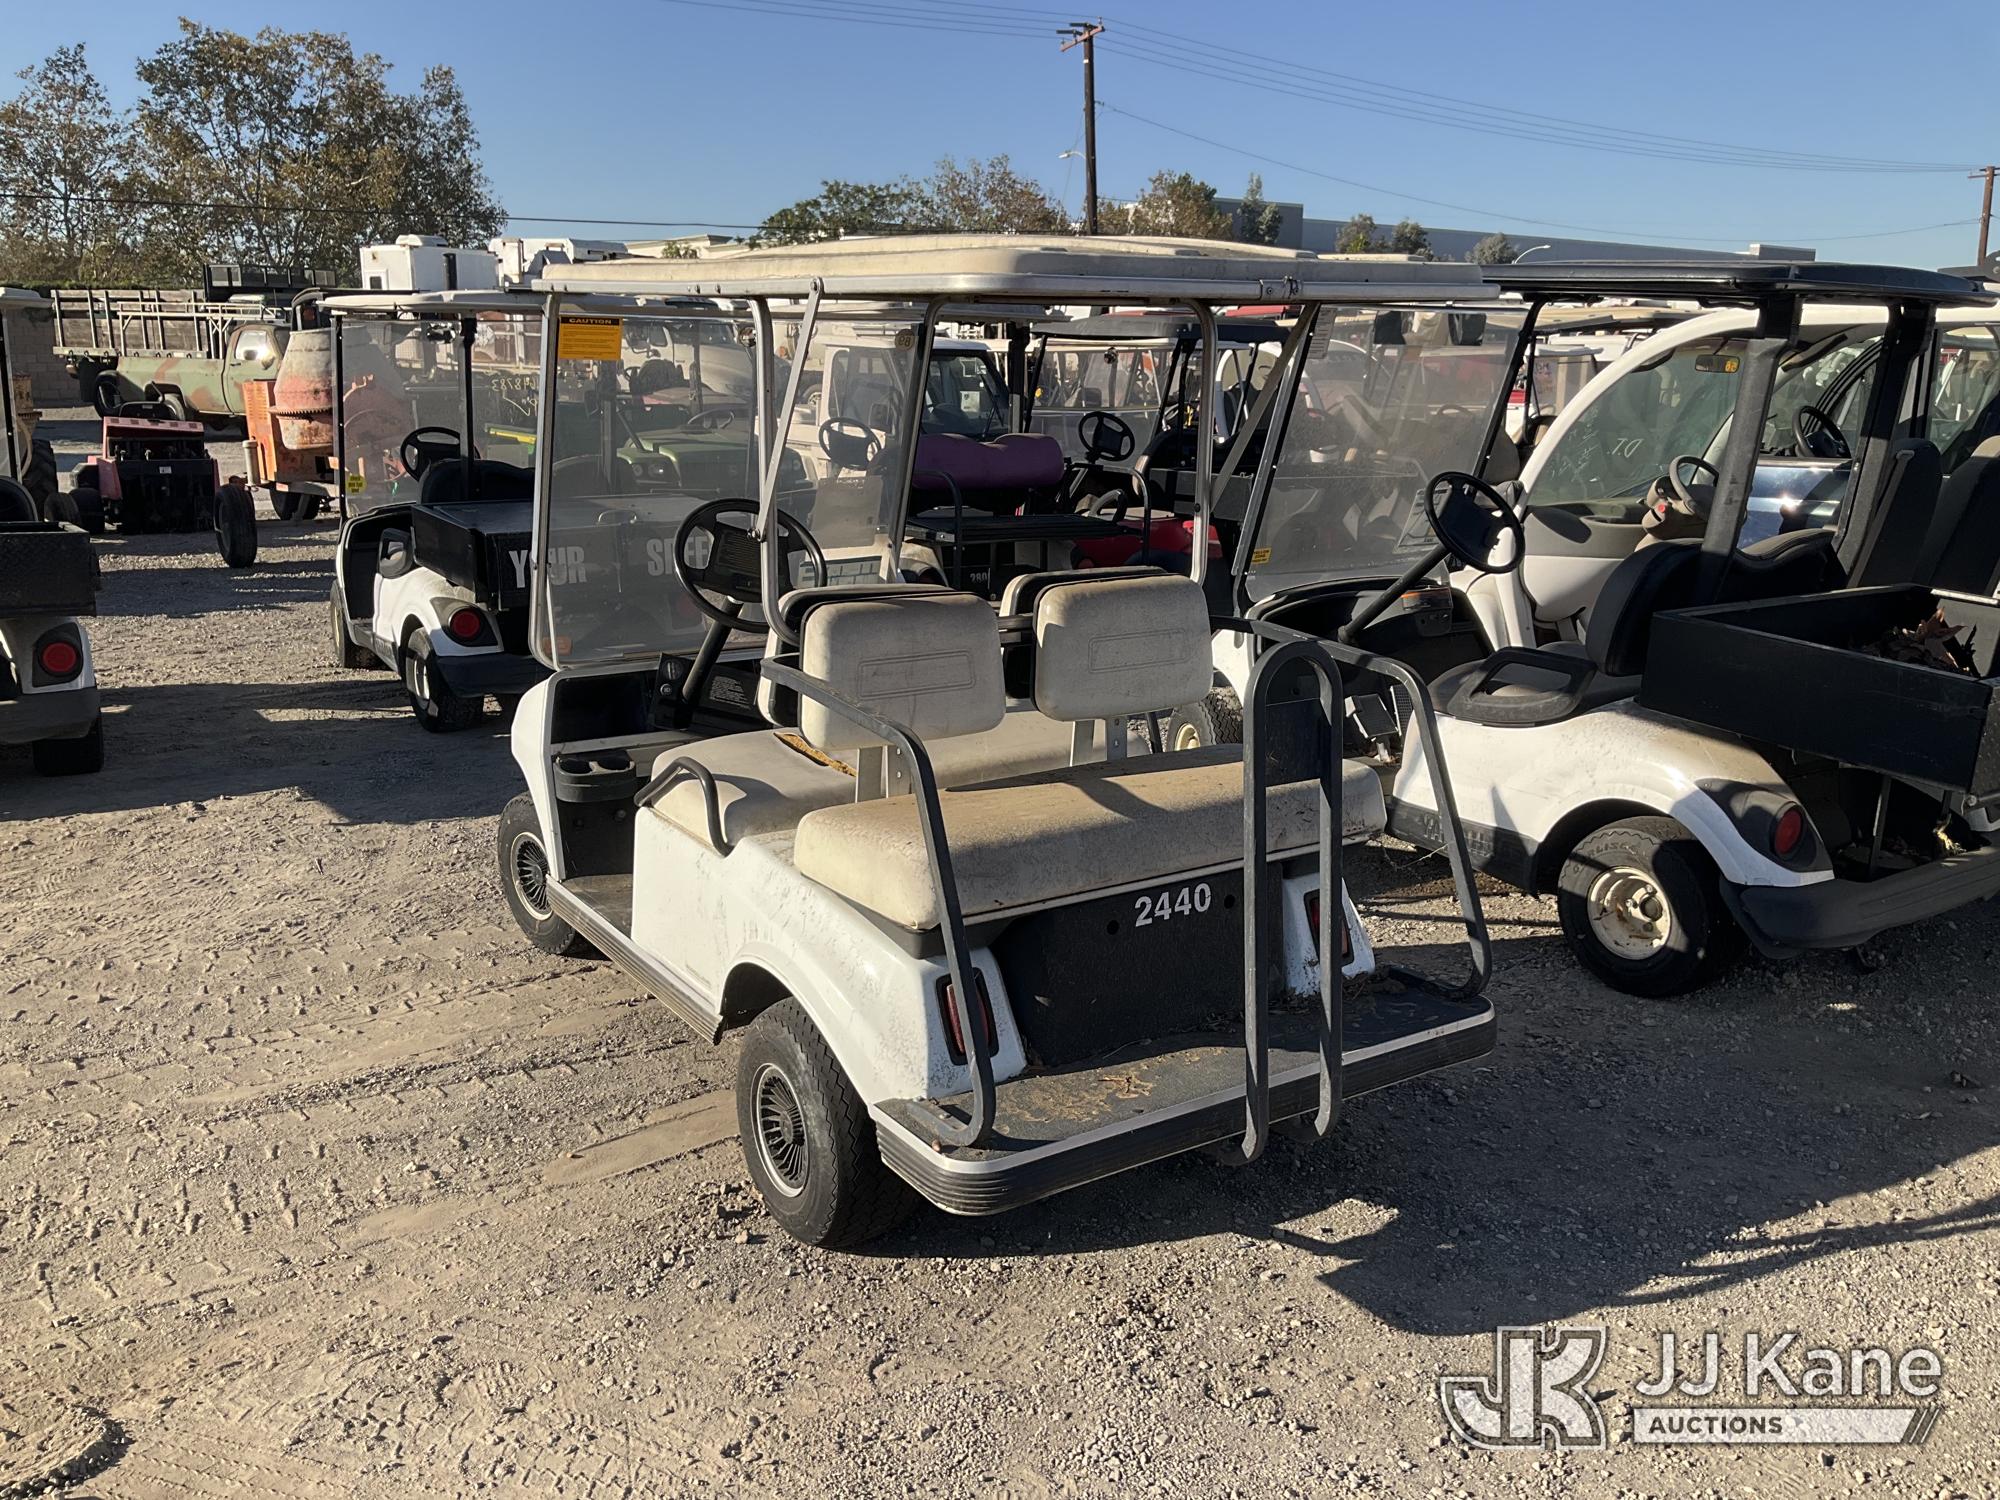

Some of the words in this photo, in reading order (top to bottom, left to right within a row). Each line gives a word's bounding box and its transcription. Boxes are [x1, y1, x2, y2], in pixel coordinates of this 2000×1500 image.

[568, 317, 612, 325] CAUTION
[508, 545, 587, 589] YUR
[646, 535, 709, 577] SPEE
[1134, 882, 1212, 927] 2440
